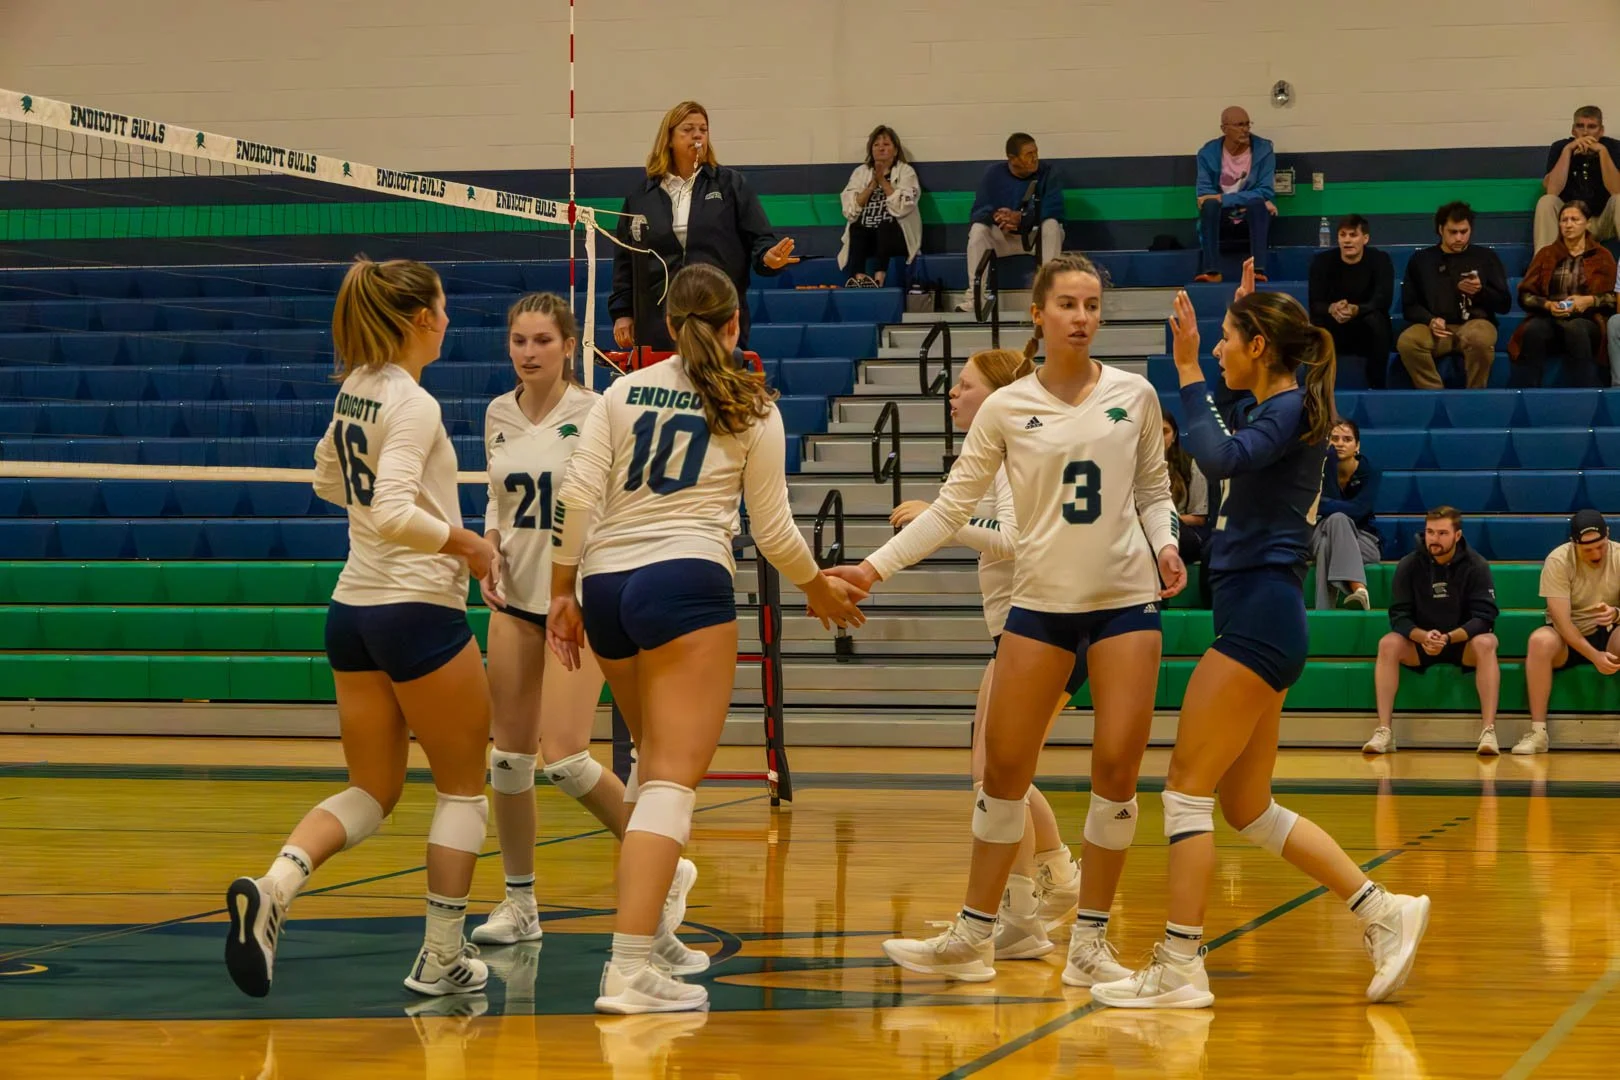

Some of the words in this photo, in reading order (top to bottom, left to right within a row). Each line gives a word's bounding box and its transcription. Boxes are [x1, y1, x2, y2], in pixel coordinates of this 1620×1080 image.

[70, 105, 128, 136] ENDICOTT
[131, 118, 166, 144] GULLS
[236, 140, 286, 168] ENDICOTT
[287, 154, 317, 174] GULLS
[376, 168, 419, 193] ENDICOTT
[420, 178, 446, 198] GULLS
[496, 191, 534, 214] ENDICOTT
[535, 199, 557, 218] GULLS
[336, 392, 382, 424] NDICOTT
[625, 386, 703, 410] ENDICO
[333, 420, 376, 507] 16
[623, 411, 711, 496] 10
[504, 471, 552, 530] 21
[1062, 460, 1102, 525] 3
